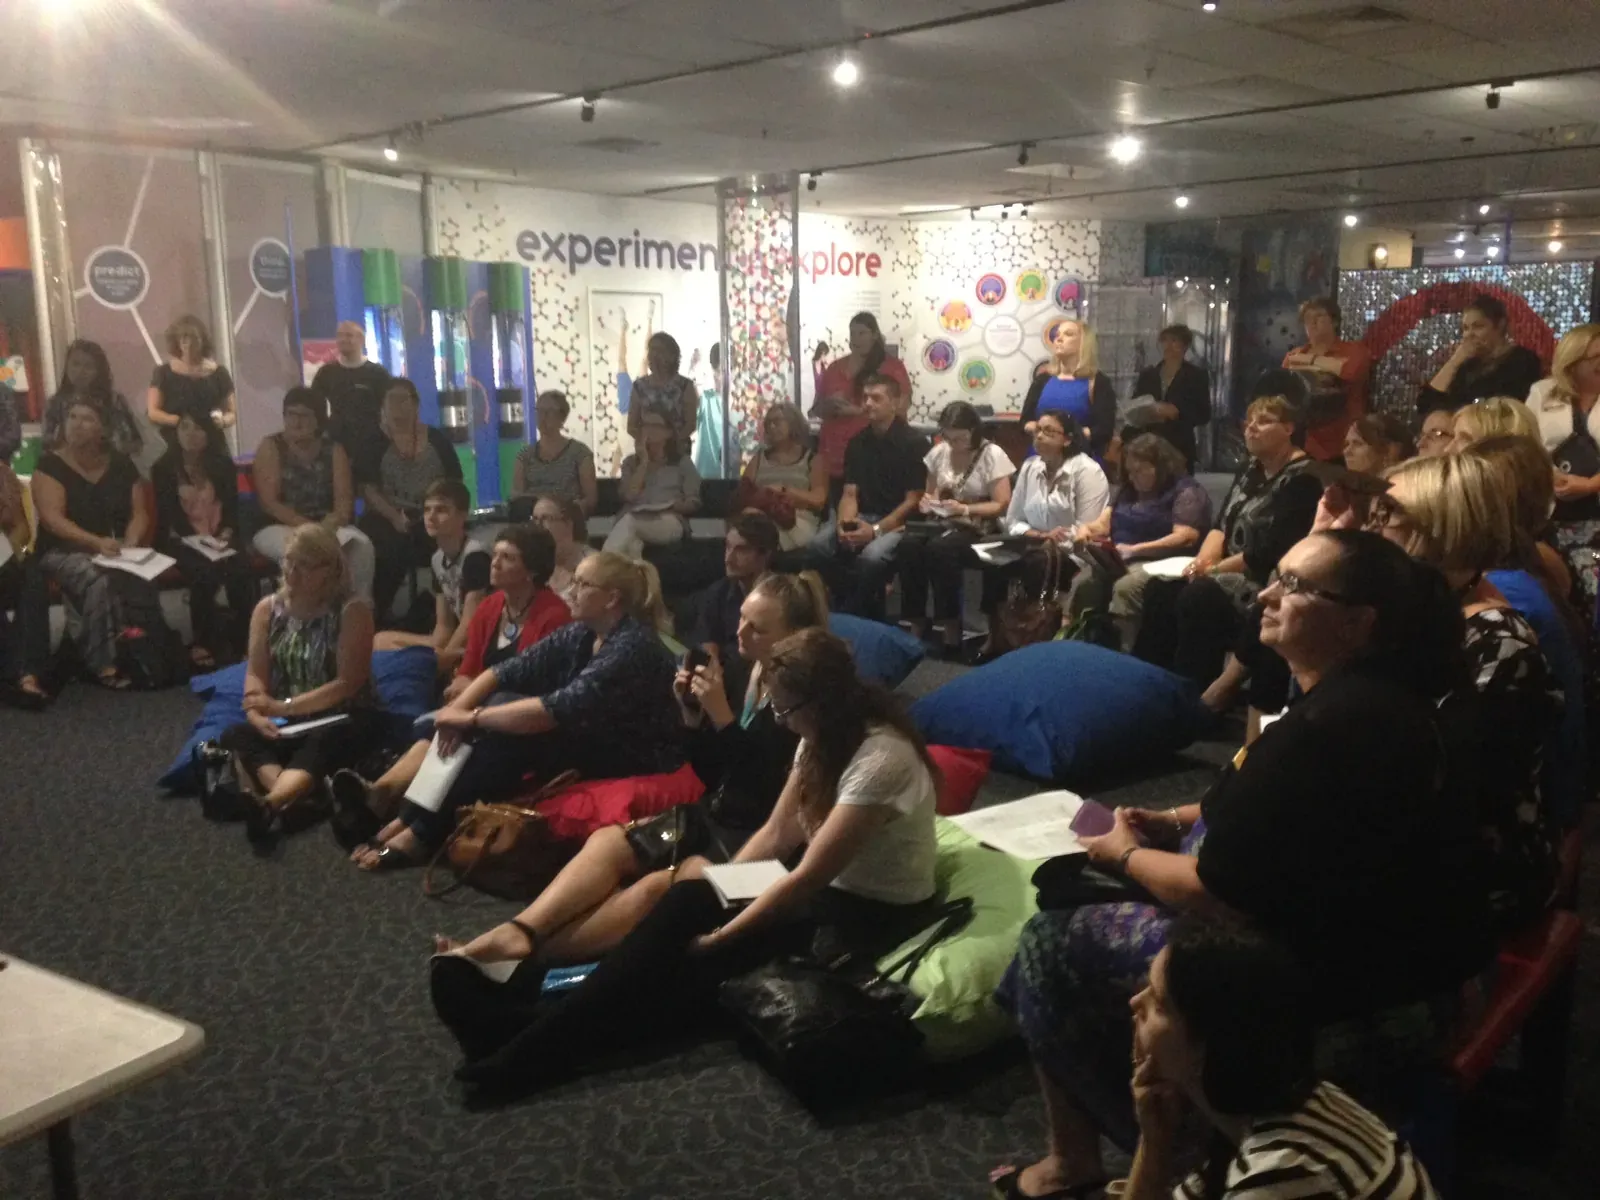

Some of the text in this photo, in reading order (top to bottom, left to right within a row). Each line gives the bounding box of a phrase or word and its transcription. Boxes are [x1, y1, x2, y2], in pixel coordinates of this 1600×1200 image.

[94, 263, 141, 278] predict
[516, 229, 882, 284] experimen xplore
